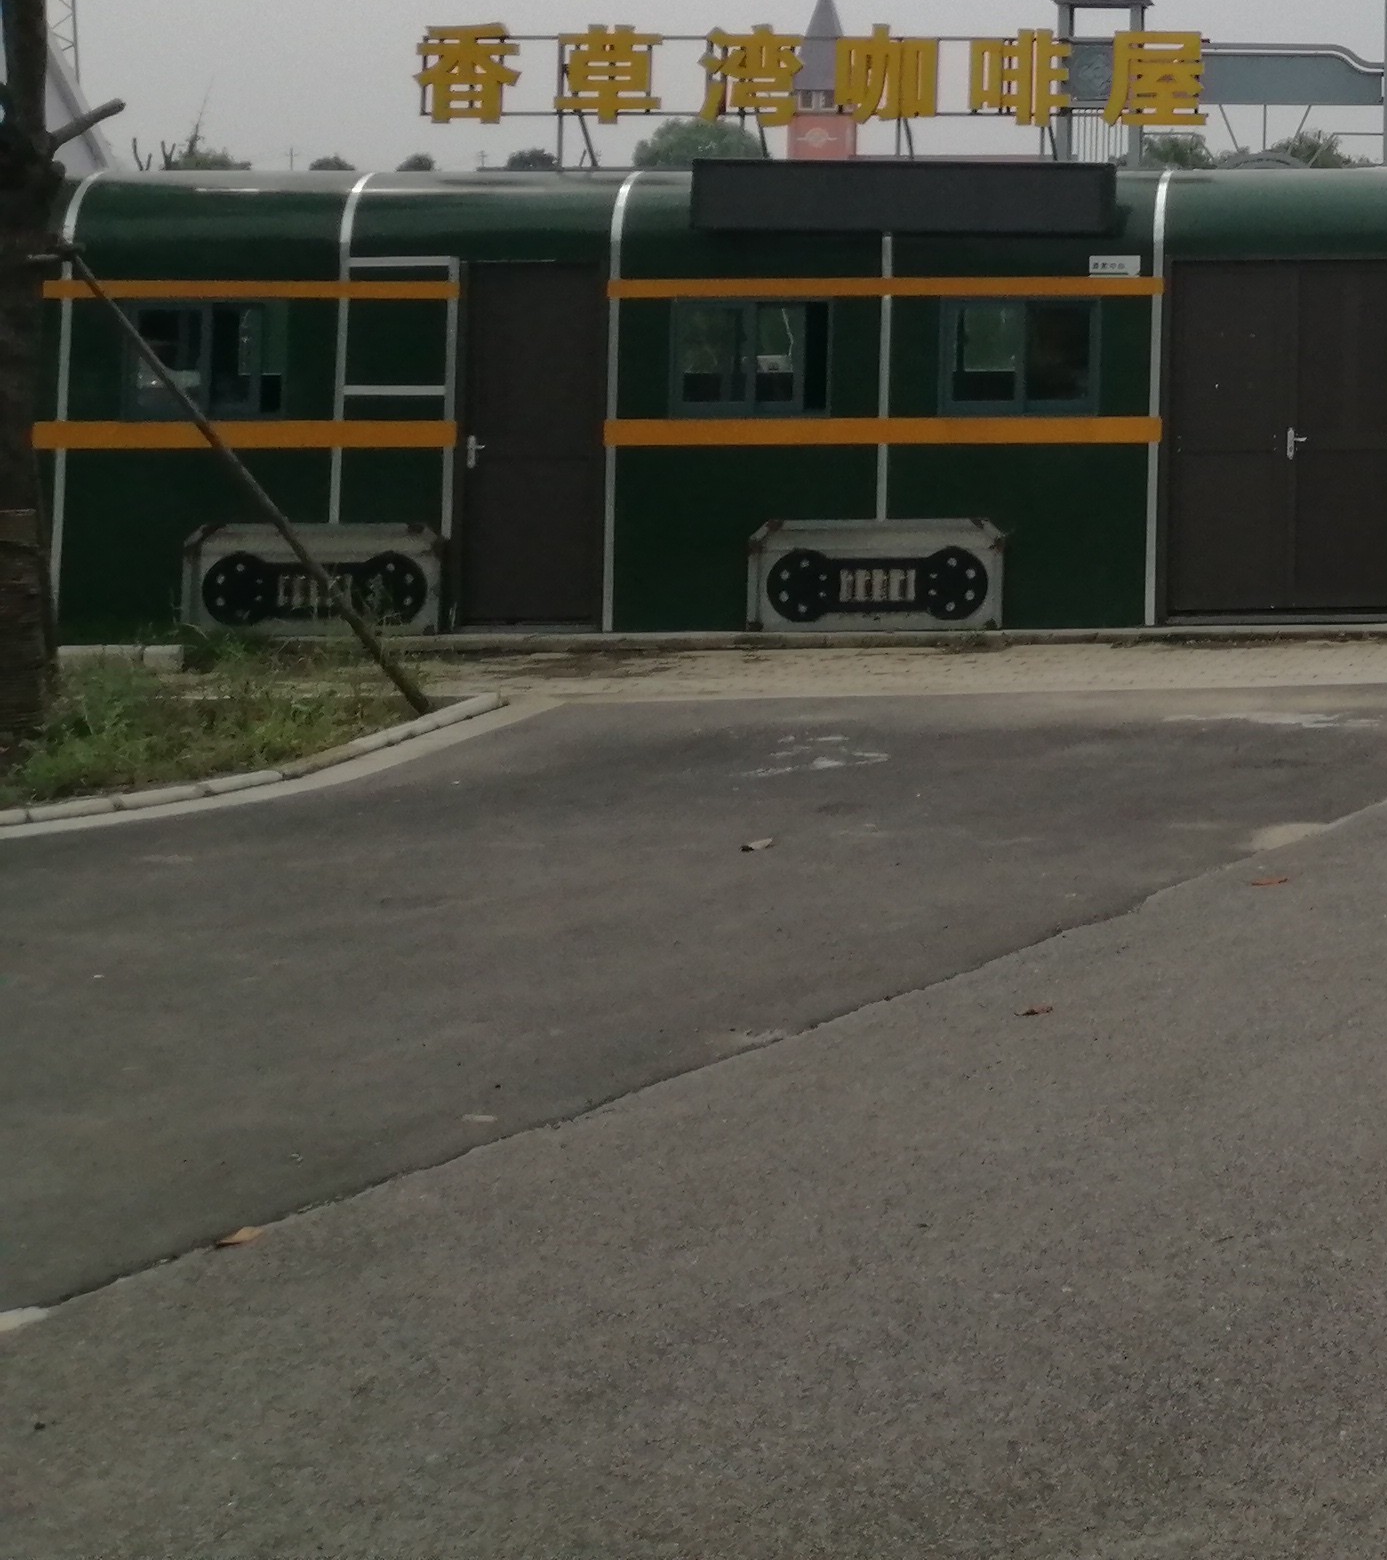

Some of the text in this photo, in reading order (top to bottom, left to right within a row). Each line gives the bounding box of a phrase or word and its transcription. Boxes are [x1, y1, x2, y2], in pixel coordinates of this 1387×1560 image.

[414, 23, 1208, 127] 香草湾咖啡屋
